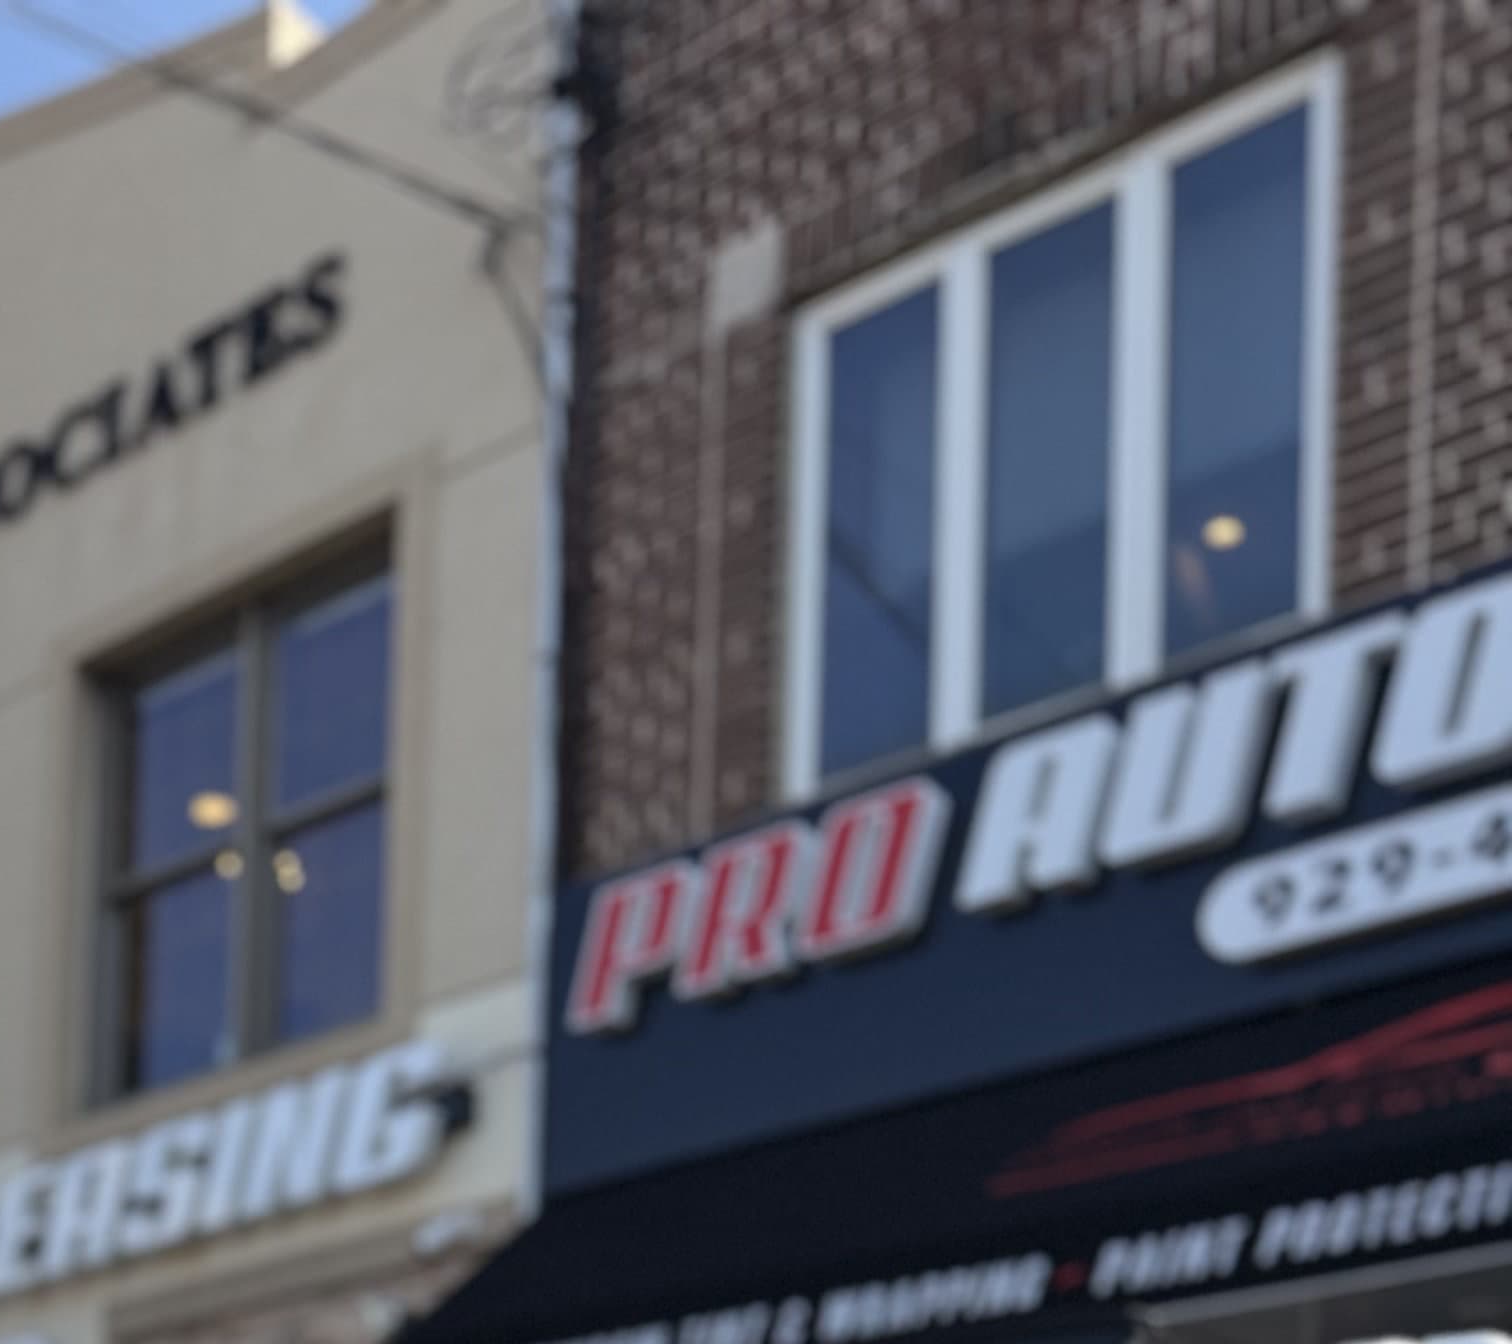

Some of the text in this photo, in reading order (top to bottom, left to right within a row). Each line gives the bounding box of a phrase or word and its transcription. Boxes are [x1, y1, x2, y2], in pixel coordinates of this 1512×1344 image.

[566, 573, 1512, 1033] PRO AUTO
[1090, 1212, 1252, 1300] PAINT
